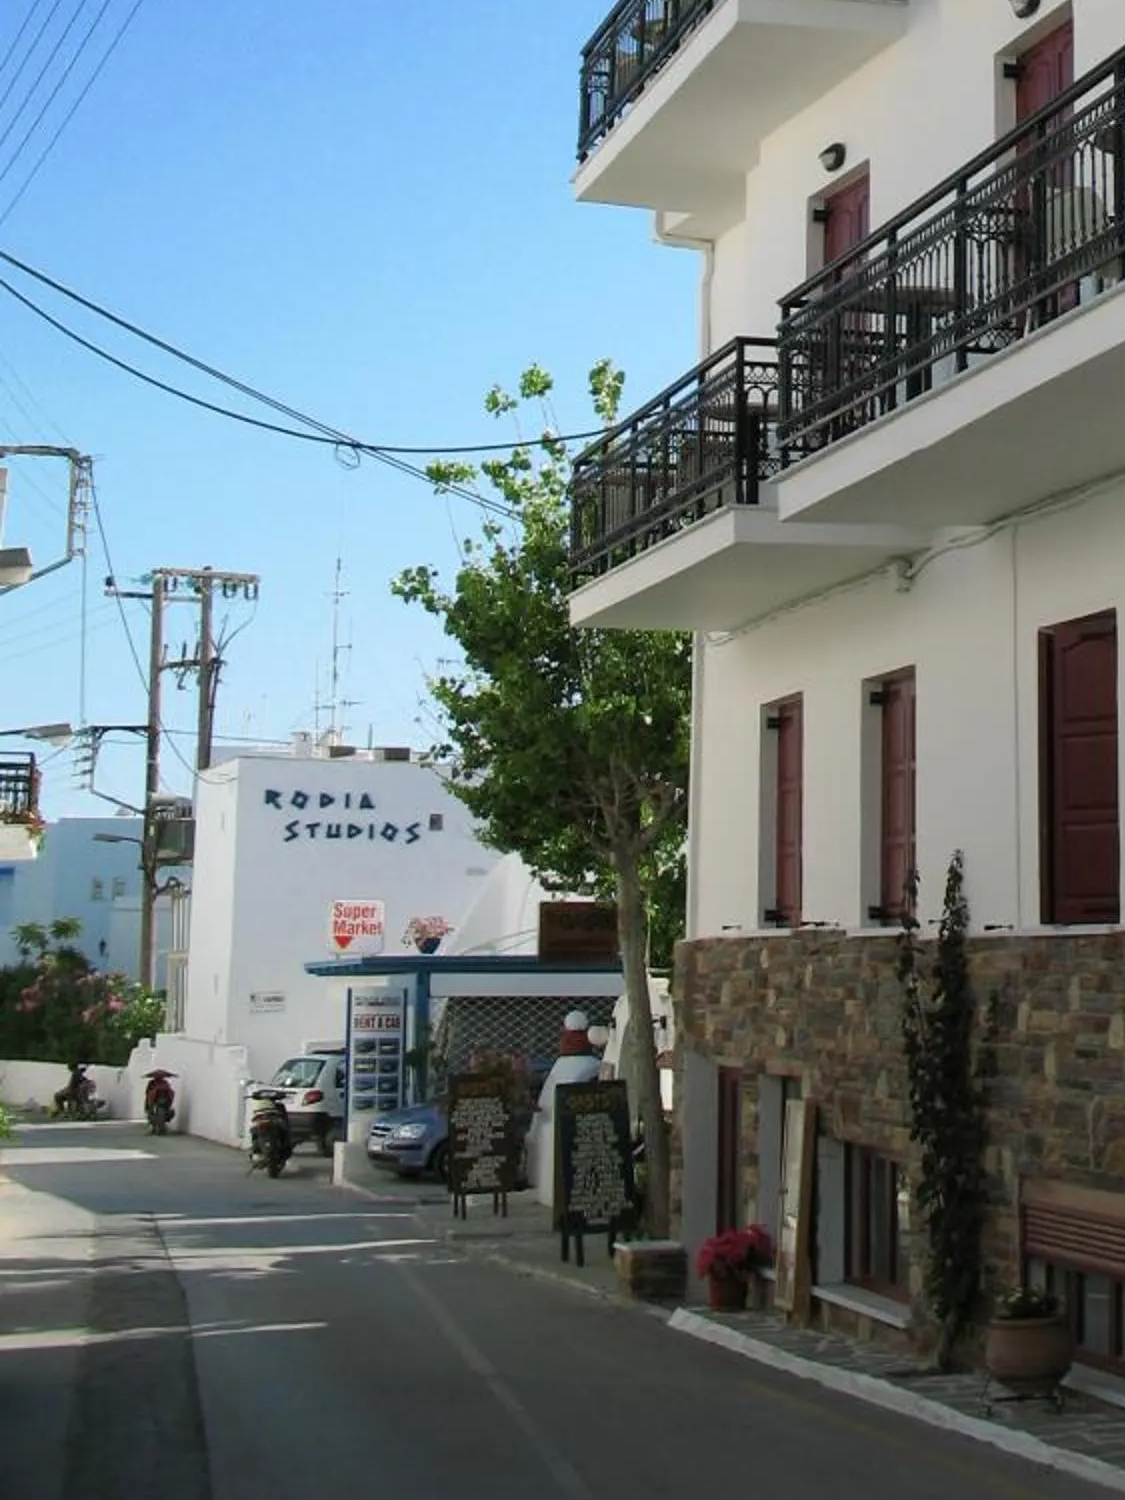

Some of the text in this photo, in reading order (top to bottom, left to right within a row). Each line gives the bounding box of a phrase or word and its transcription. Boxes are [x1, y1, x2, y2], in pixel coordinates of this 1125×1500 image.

[264, 788, 376, 810] RODIA
[283, 819, 421, 845] STUDIOS
[333, 902, 376, 920] Super
[333, 919, 382, 936] Market
